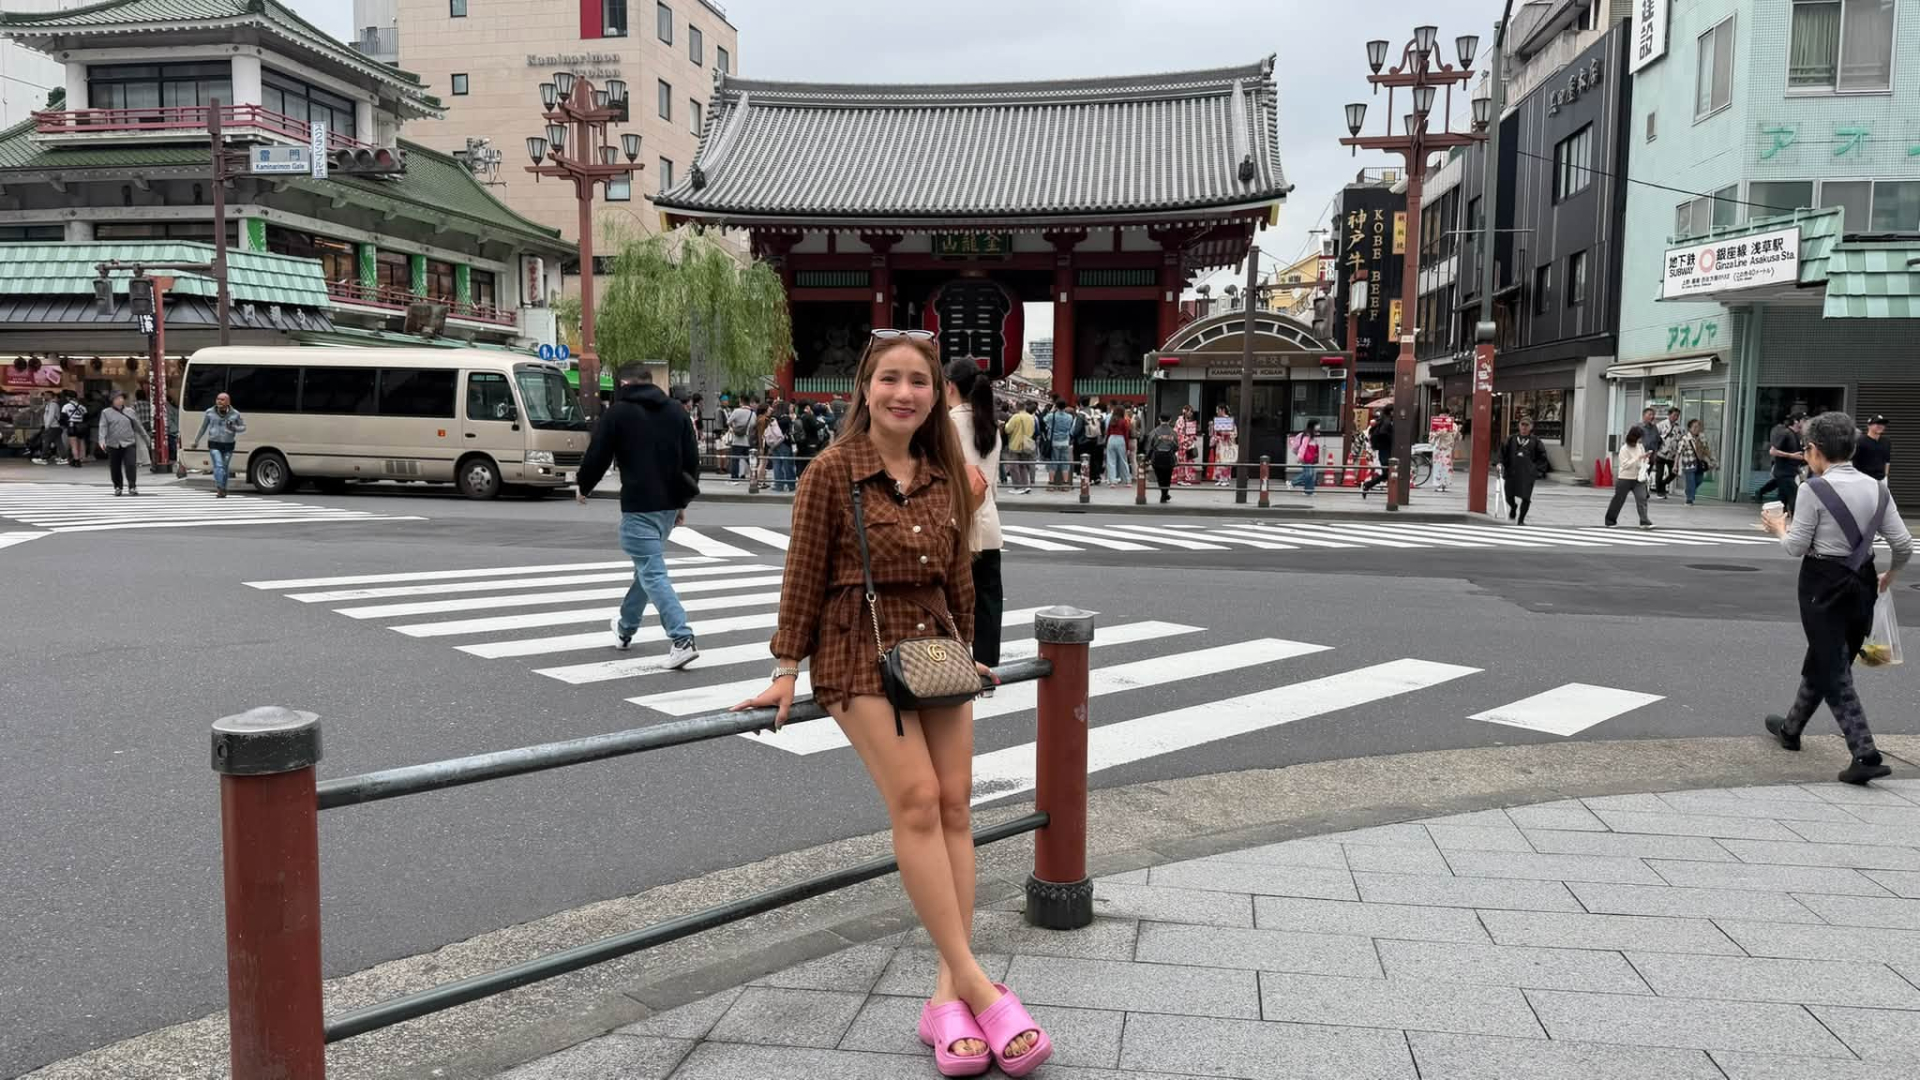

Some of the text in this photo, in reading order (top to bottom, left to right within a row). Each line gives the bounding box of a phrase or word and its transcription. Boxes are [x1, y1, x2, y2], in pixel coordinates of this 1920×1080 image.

[1346, 208, 1367, 270] 神戸牛
[1716, 238, 1784, 260] 銀座線 浅草駅
[1369, 209, 1384, 322] KOBE BEEF
[1669, 253, 1696, 269] 地下鉄
[1715, 250, 1795, 271] Ginza Line Asakusa Sta.
[1669, 267, 1694, 278] SUBWAY
[1667, 321, 1717, 351] アオノヤ
